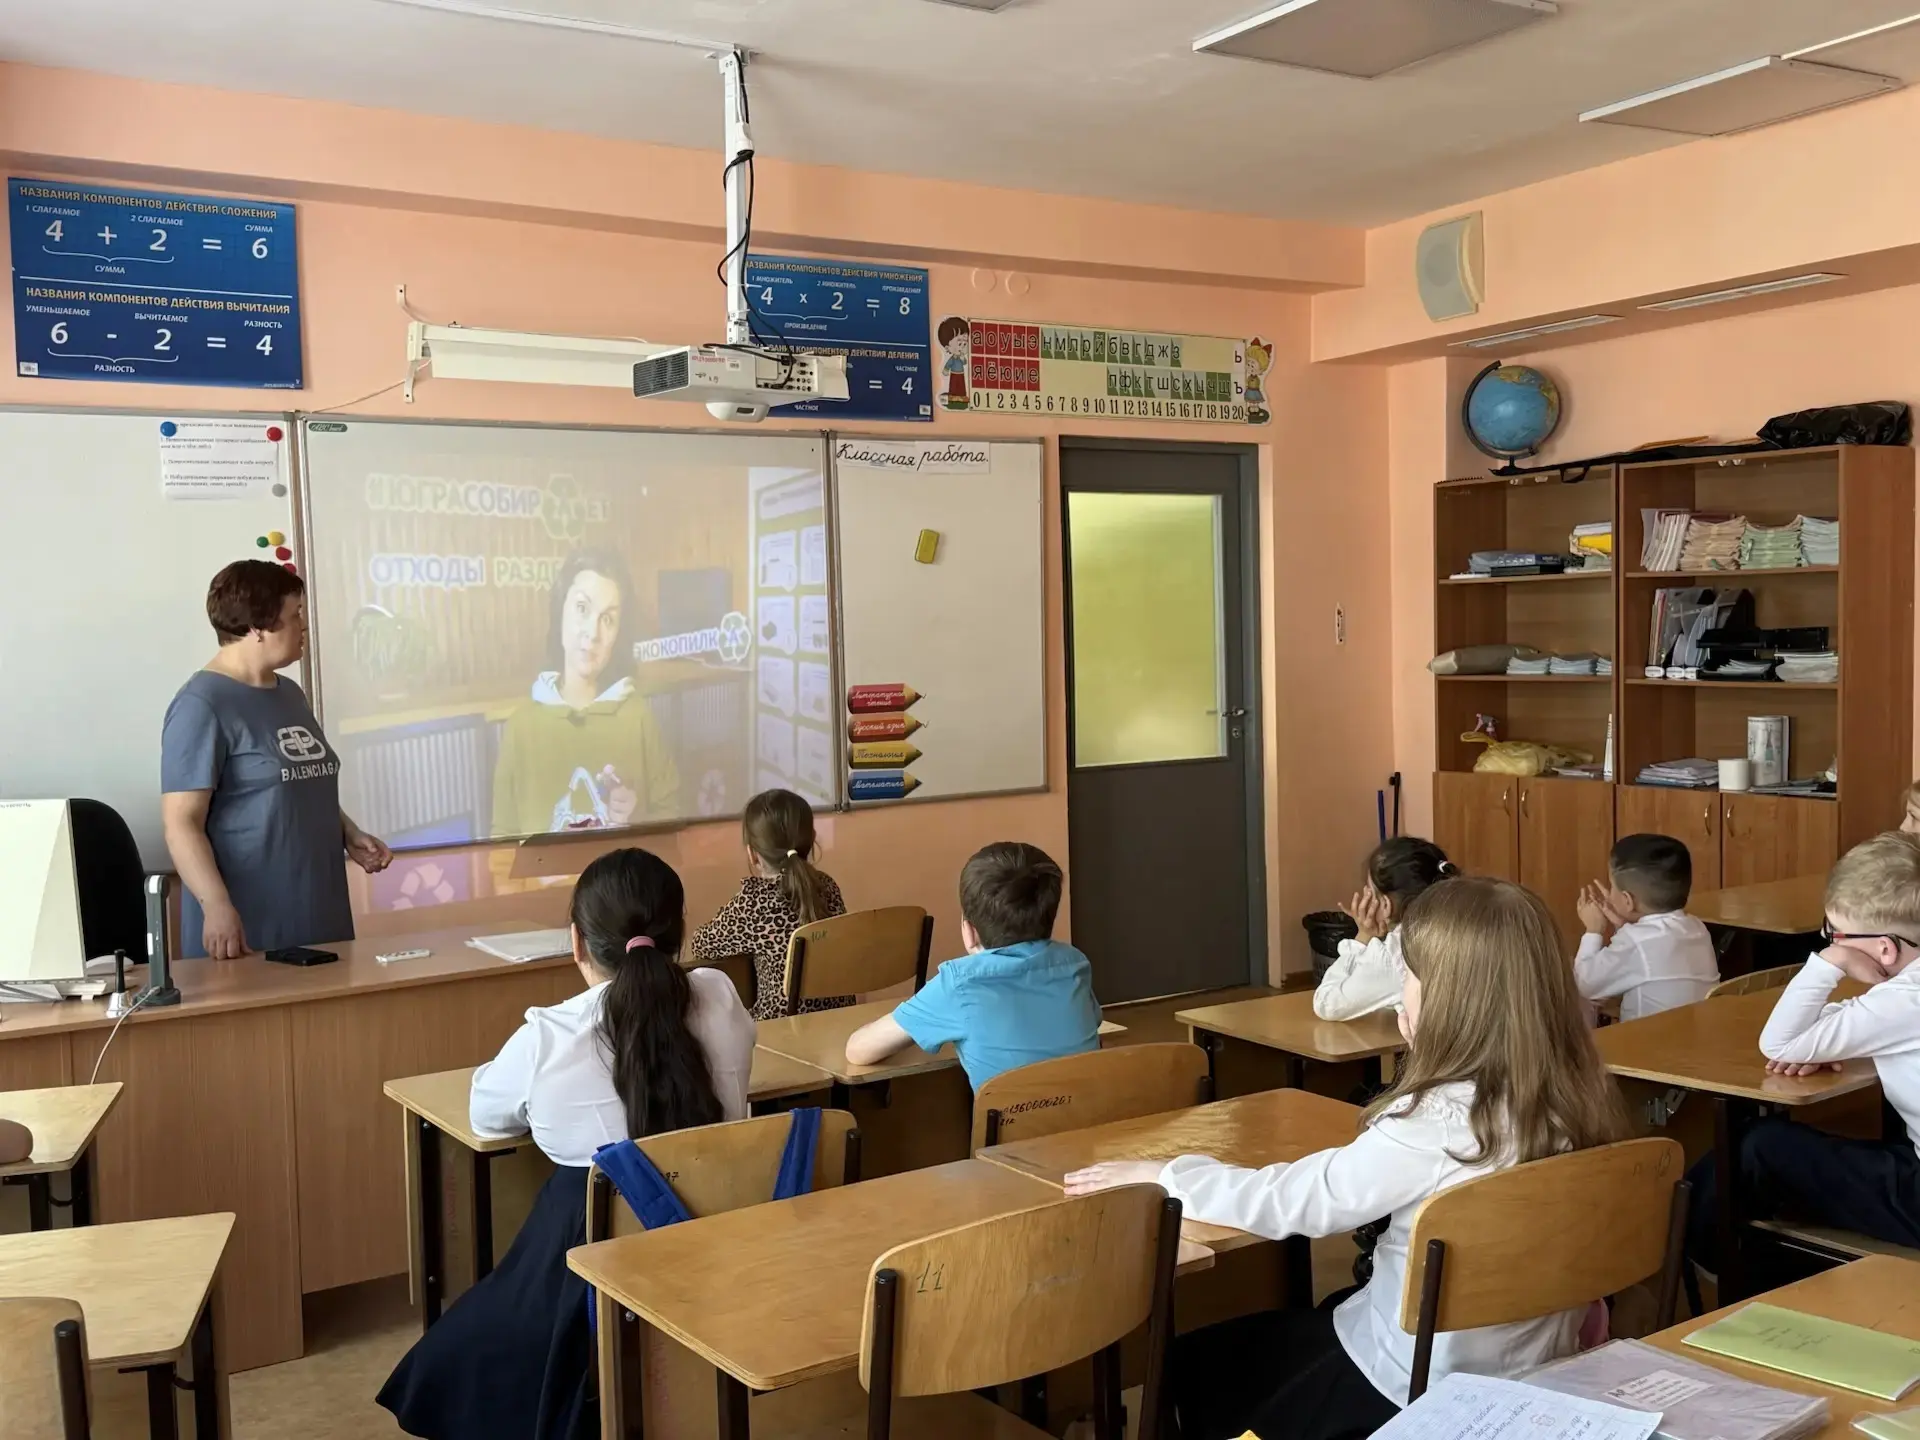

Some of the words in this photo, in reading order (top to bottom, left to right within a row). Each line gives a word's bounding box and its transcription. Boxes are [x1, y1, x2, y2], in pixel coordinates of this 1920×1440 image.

[20, 186, 80, 201] НАЗВАНИЯ
[83, 193, 162, 210] КОМПОНЕНТОВ
[165, 201, 218, 214] ДЕЙСТВИЯ
[221, 206, 277, 219] СЛОЖЕНИЯ
[32, 205, 80, 217] СЛАГАЕМОЕ
[137, 215, 184, 226] СЛАГАЕМОЕ
[244, 224, 273, 233] СУММА
[45, 219, 64, 242] 4
[149, 228, 168, 251] 2
[252, 237, 268, 259] 6
[94, 264, 126, 274] СУММА
[786, 264, 840, 275] КОМПОНЕНТОВ
[841, 267, 878, 278] ДЕЙСТВИЯ
[878, 270, 923, 282] УМНОЖЕНИЯ
[26, 287, 86, 300] НАЗВАНИЯ
[88, 291, 168, 307] КОМПОНЕНТОВ
[171, 297, 224, 310] ДЕЙСТВИЯ
[226, 301, 290, 314] ВЫЧИТАНИЯ
[760, 286, 774, 305] 4
[831, 292, 844, 310] 2
[899, 296, 911, 315] 8
[25, 304, 91, 316] УМЕНЬШАЕМОЕ
[134, 312, 188, 323] ВЫЧИТАЕМОЕ
[244, 319, 283, 329] РАЗНОСТЬ
[51, 321, 69, 344] 6
[153, 328, 172, 351] 2
[256, 334, 273, 356] 4
[850, 350, 886, 358] ДЕЙСТВИЯ
[887, 352, 919, 360] ДЕЛЕНИЯ
[94, 363, 136, 373] РАЗНОСТЬ
[901, 377, 913, 395] 4
[794, 404, 818, 412] ЧАСТНОЕ
[973, 392, 980, 407] 0
[985, 392, 990, 408] 1
[997, 393, 1004, 409] 2
[1010, 394, 1017, 409] 3
[1022, 395, 1029, 409] 4
[1035, 395, 1042, 410] 5
[1047, 396, 1054, 411] 6
[1059, 397, 1065, 411] 7
[1071, 397, 1078, 412] 8
[1082, 398, 1089, 413] 9
[1095, 398, 1105, 413] 10
[1110, 399, 1119, 414] 11
[1123, 400, 1134, 415] 12
[1137, 401, 1148, 416] 13
[1151, 401, 1162, 416] 14
[1166, 402, 1176, 417] 15
[1180, 403, 1190, 417] 16
[1193, 403, 1203, 418] 17
[1206, 404, 1217, 419] 18
[1220, 405, 1230, 419] 19
[1232, 405, 1244, 420] 20
[371, 556, 484, 587] ОТХОДЫ
